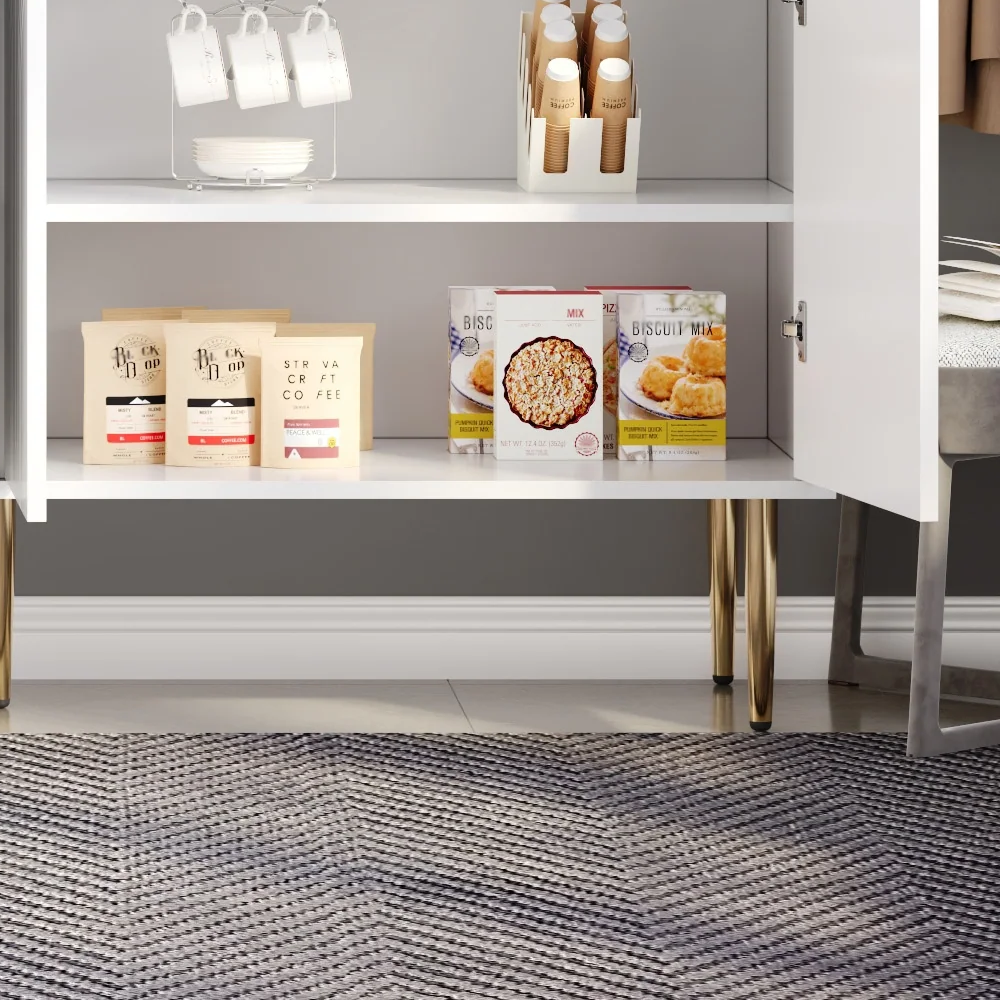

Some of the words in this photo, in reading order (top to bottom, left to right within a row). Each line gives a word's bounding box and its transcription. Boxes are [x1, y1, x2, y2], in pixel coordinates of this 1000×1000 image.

[567, 308, 585, 318] MIX
[632, 320, 683, 336] BISCUIT
[691, 320, 714, 336] MIX
